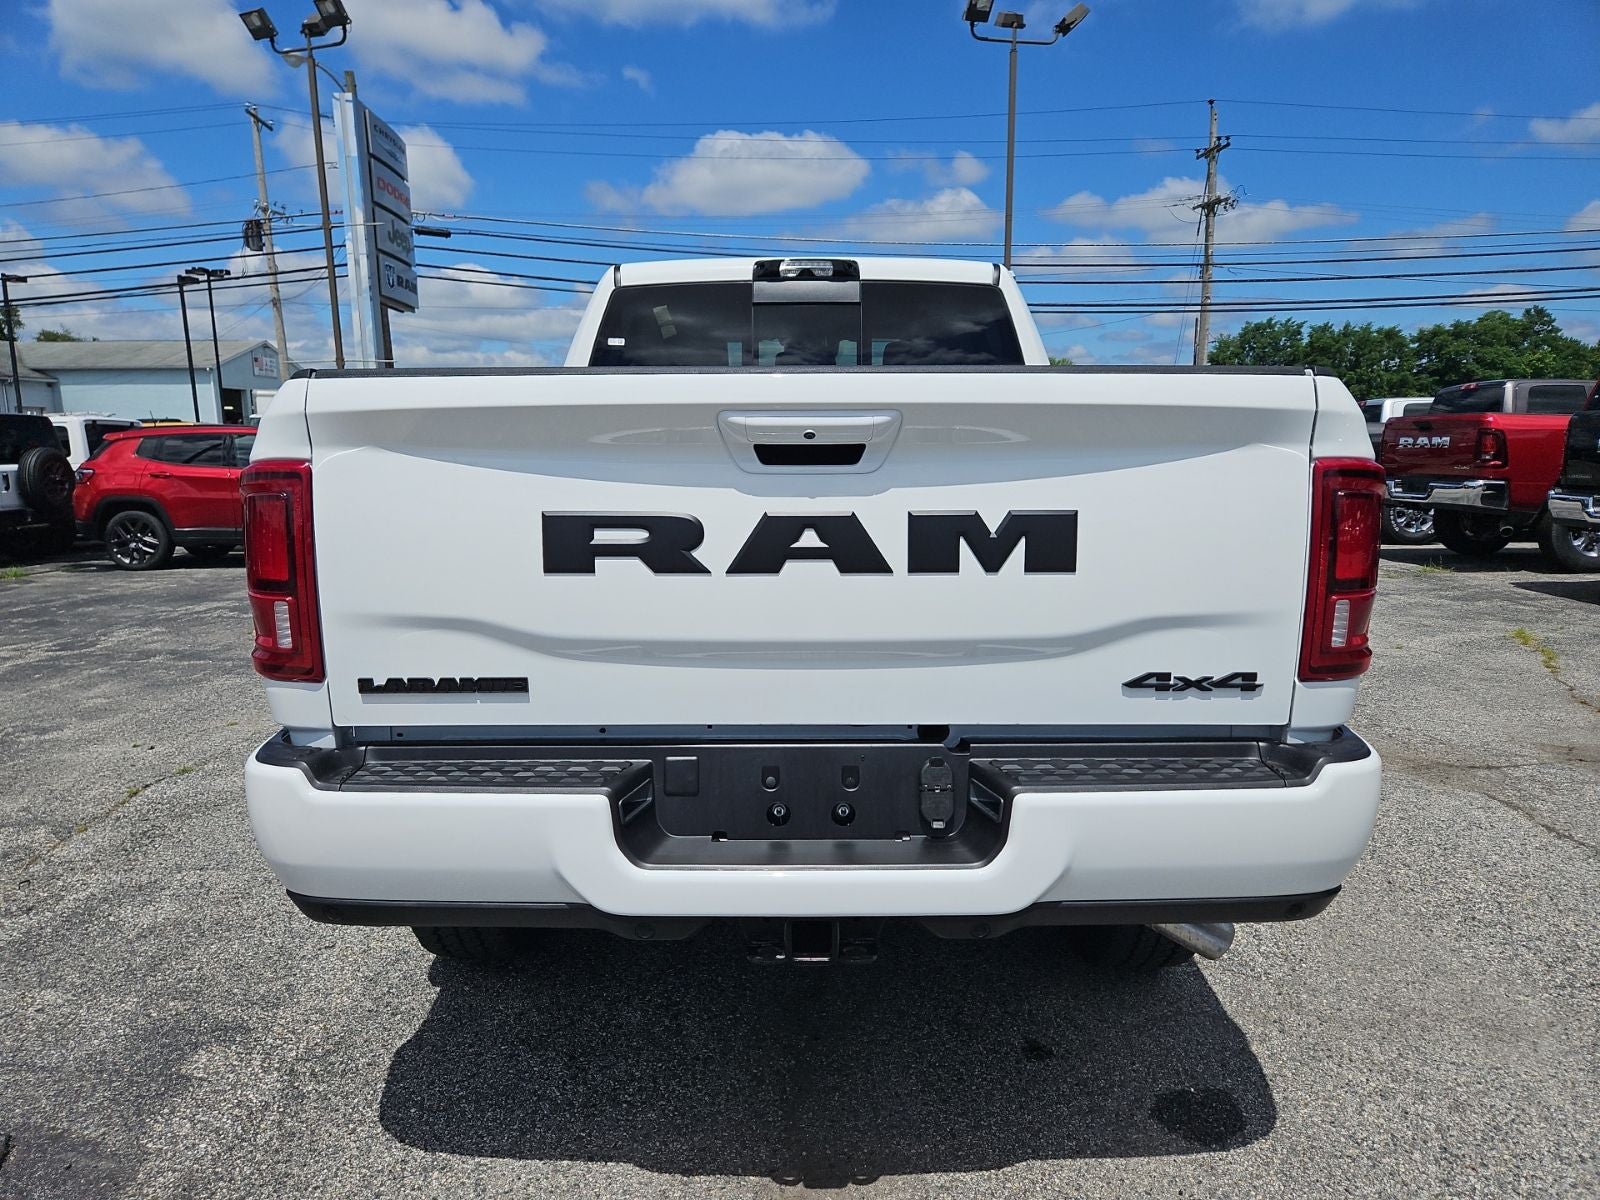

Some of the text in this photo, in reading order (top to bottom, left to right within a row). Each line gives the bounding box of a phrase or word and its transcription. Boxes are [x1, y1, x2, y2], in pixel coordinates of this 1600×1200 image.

[374, 124, 406, 155] CHRYS
[387, 220, 411, 257] Jeep
[396, 274, 417, 295] RAM
[1397, 436, 1451, 449] RAM
[541, 510, 1078, 576] RAM
[1121, 671, 1264, 692] 4x4
